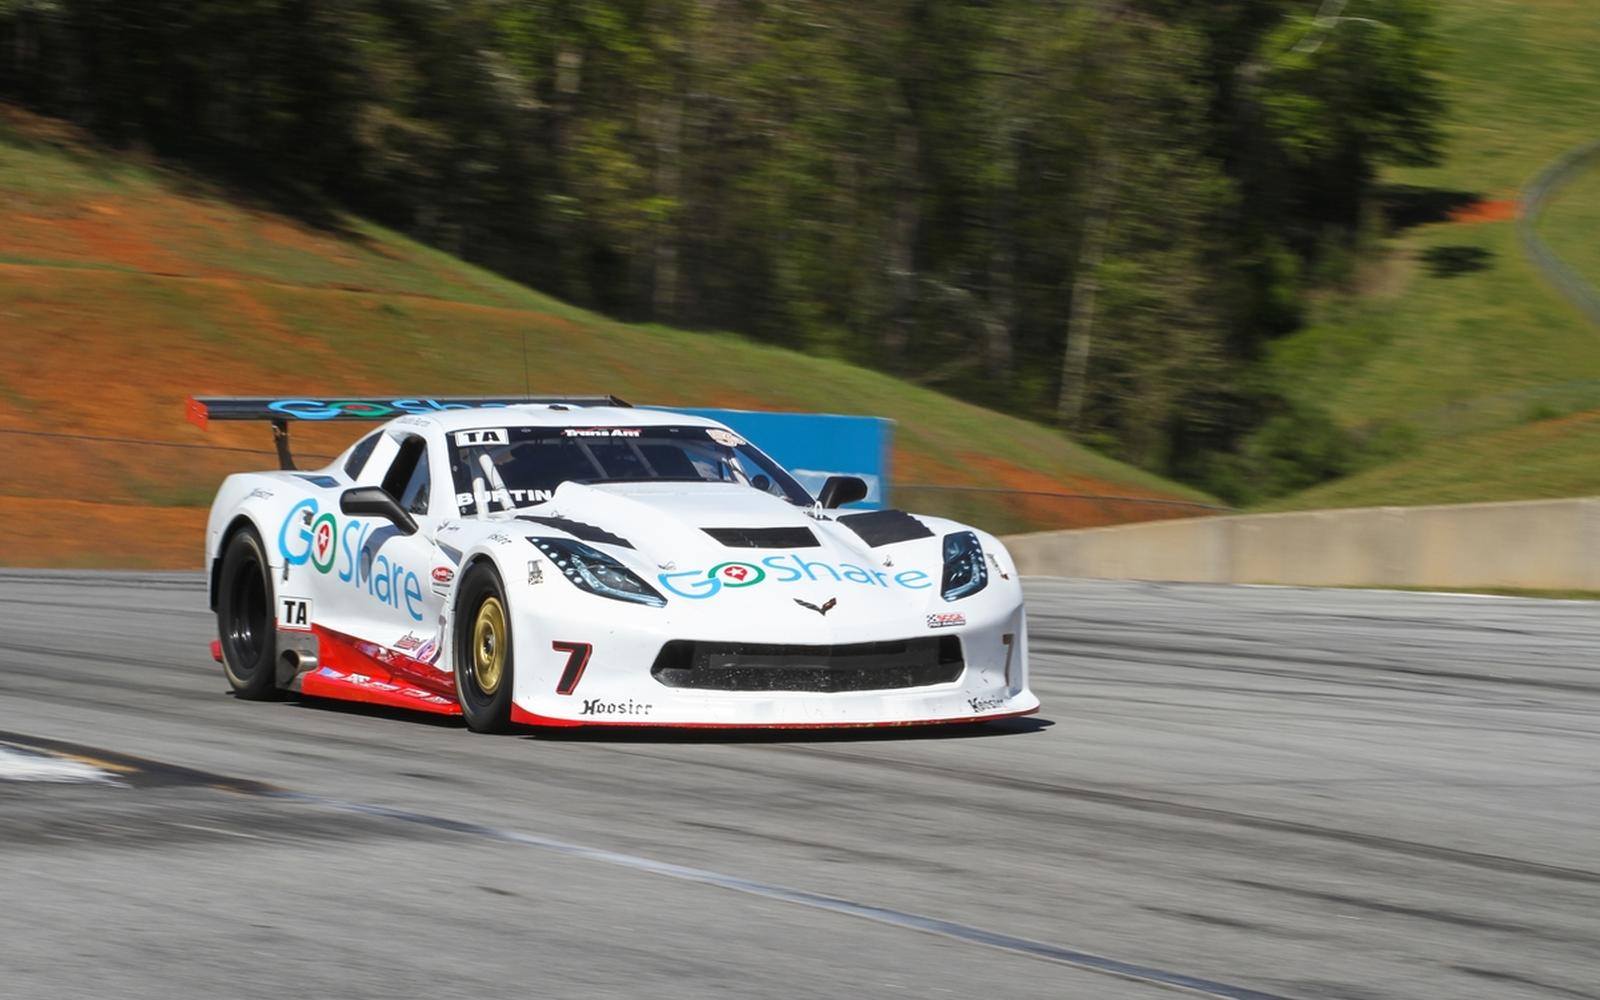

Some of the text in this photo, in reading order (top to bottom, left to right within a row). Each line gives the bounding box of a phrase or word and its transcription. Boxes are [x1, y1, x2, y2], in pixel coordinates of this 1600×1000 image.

[463, 431, 500, 443] TA
[564, 428, 640, 437] Trans Am
[284, 600, 307, 625] TA
[552, 640, 592, 695] 7
